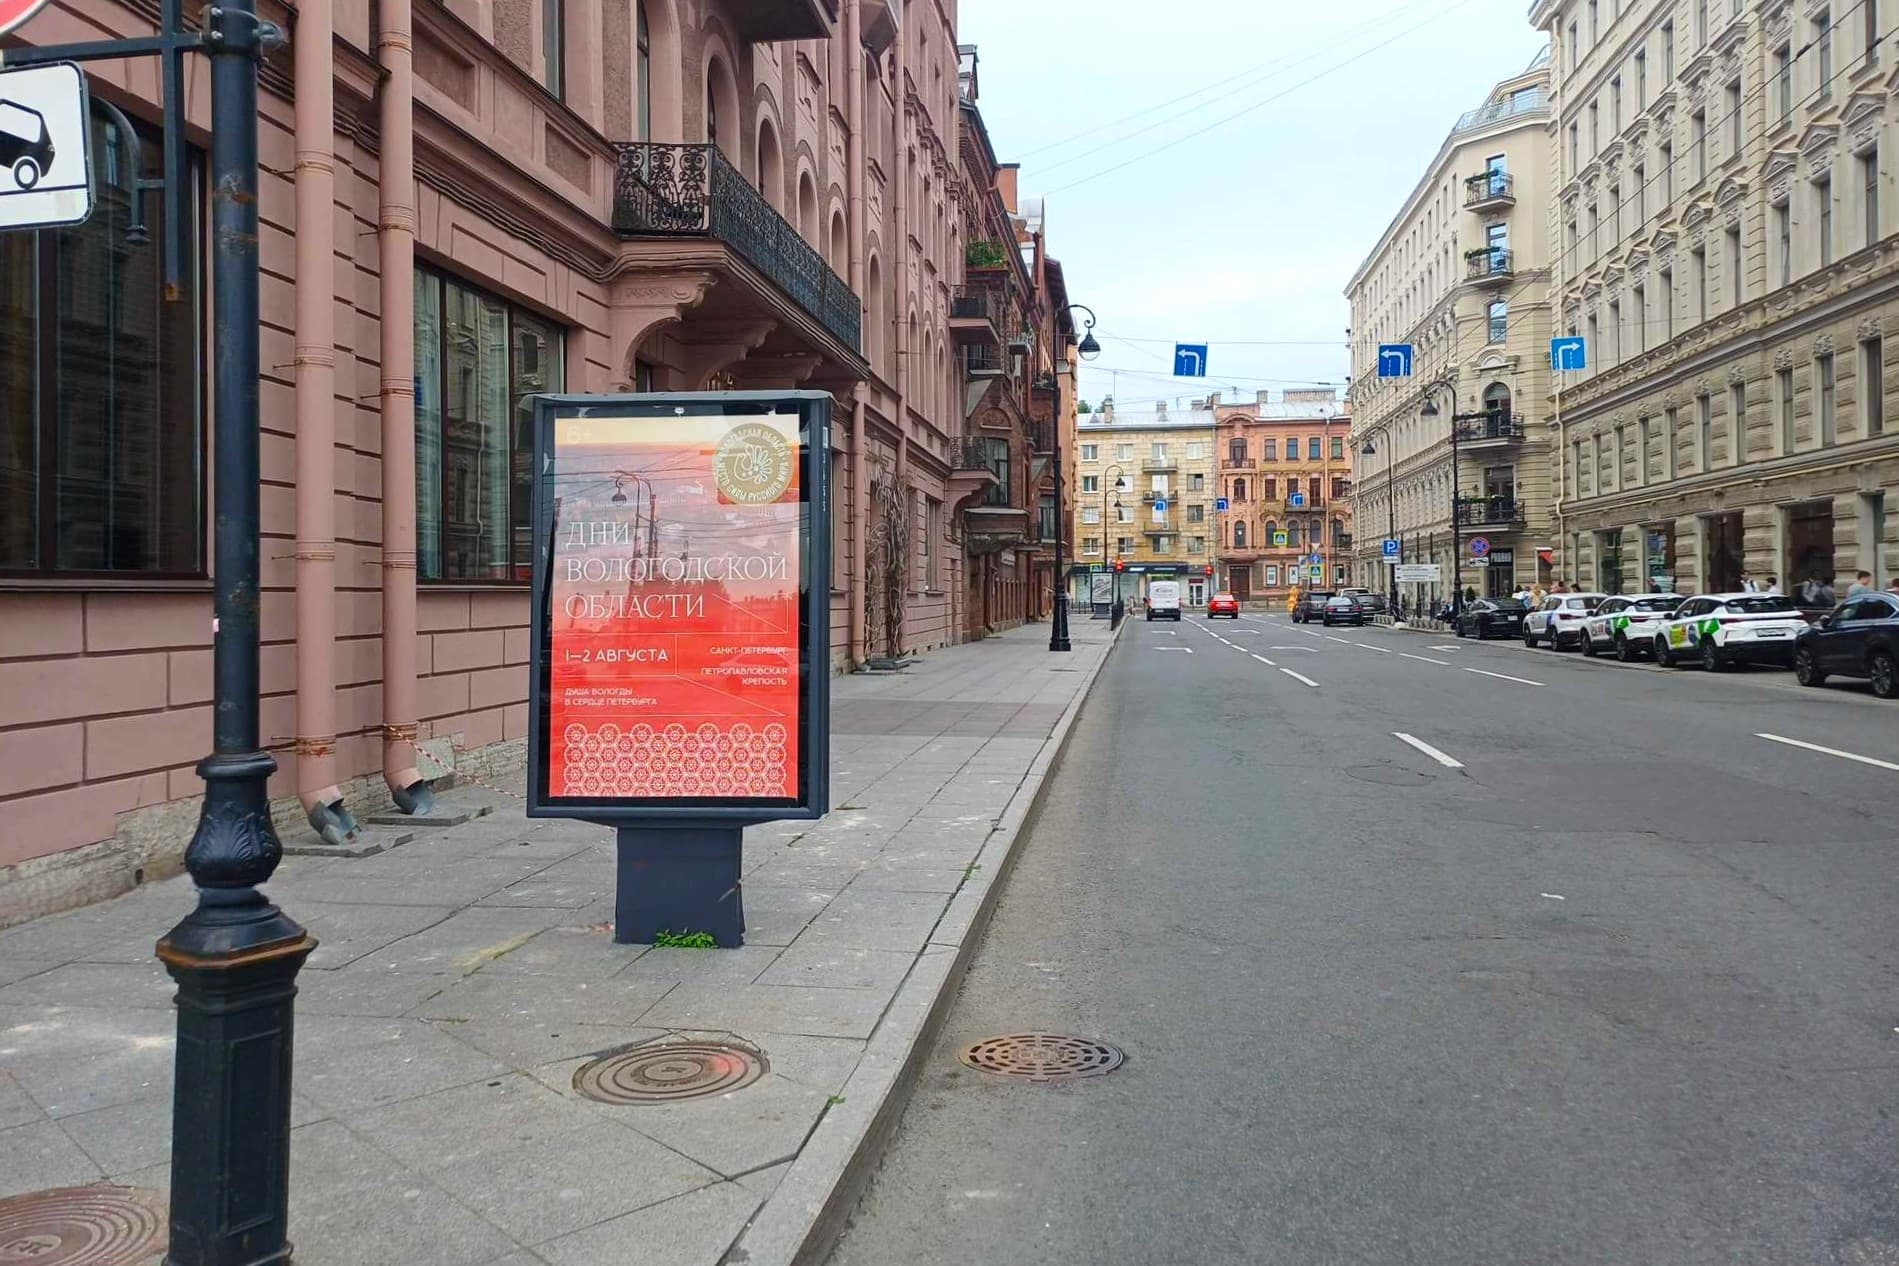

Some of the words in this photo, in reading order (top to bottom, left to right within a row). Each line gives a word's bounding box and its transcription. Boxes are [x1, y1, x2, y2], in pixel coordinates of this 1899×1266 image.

[565, 521, 631, 549] ДНИ
[566, 552, 787, 583] ВОЛОГОДСКОЙ
[565, 593, 705, 618] ОБЛАСТИ
[595, 648, 669, 662] АВГУСТА
[710, 646, 787, 655] САНКТ-ПЕТЕРБУРГ
[701, 667, 788, 675] ПЕТРОПАВЛОВСКАЯ
[742, 677, 788, 686] КРЕПОСТЬ
[565, 688, 589, 696] ДУША
[591, 687, 633, 696] ВОЛОГДЫ
[565, 698, 571, 706] В
[572, 697, 605, 706] СЕРДЦЕ
[606, 697, 658, 706] ПЕТЕРБУРГА
